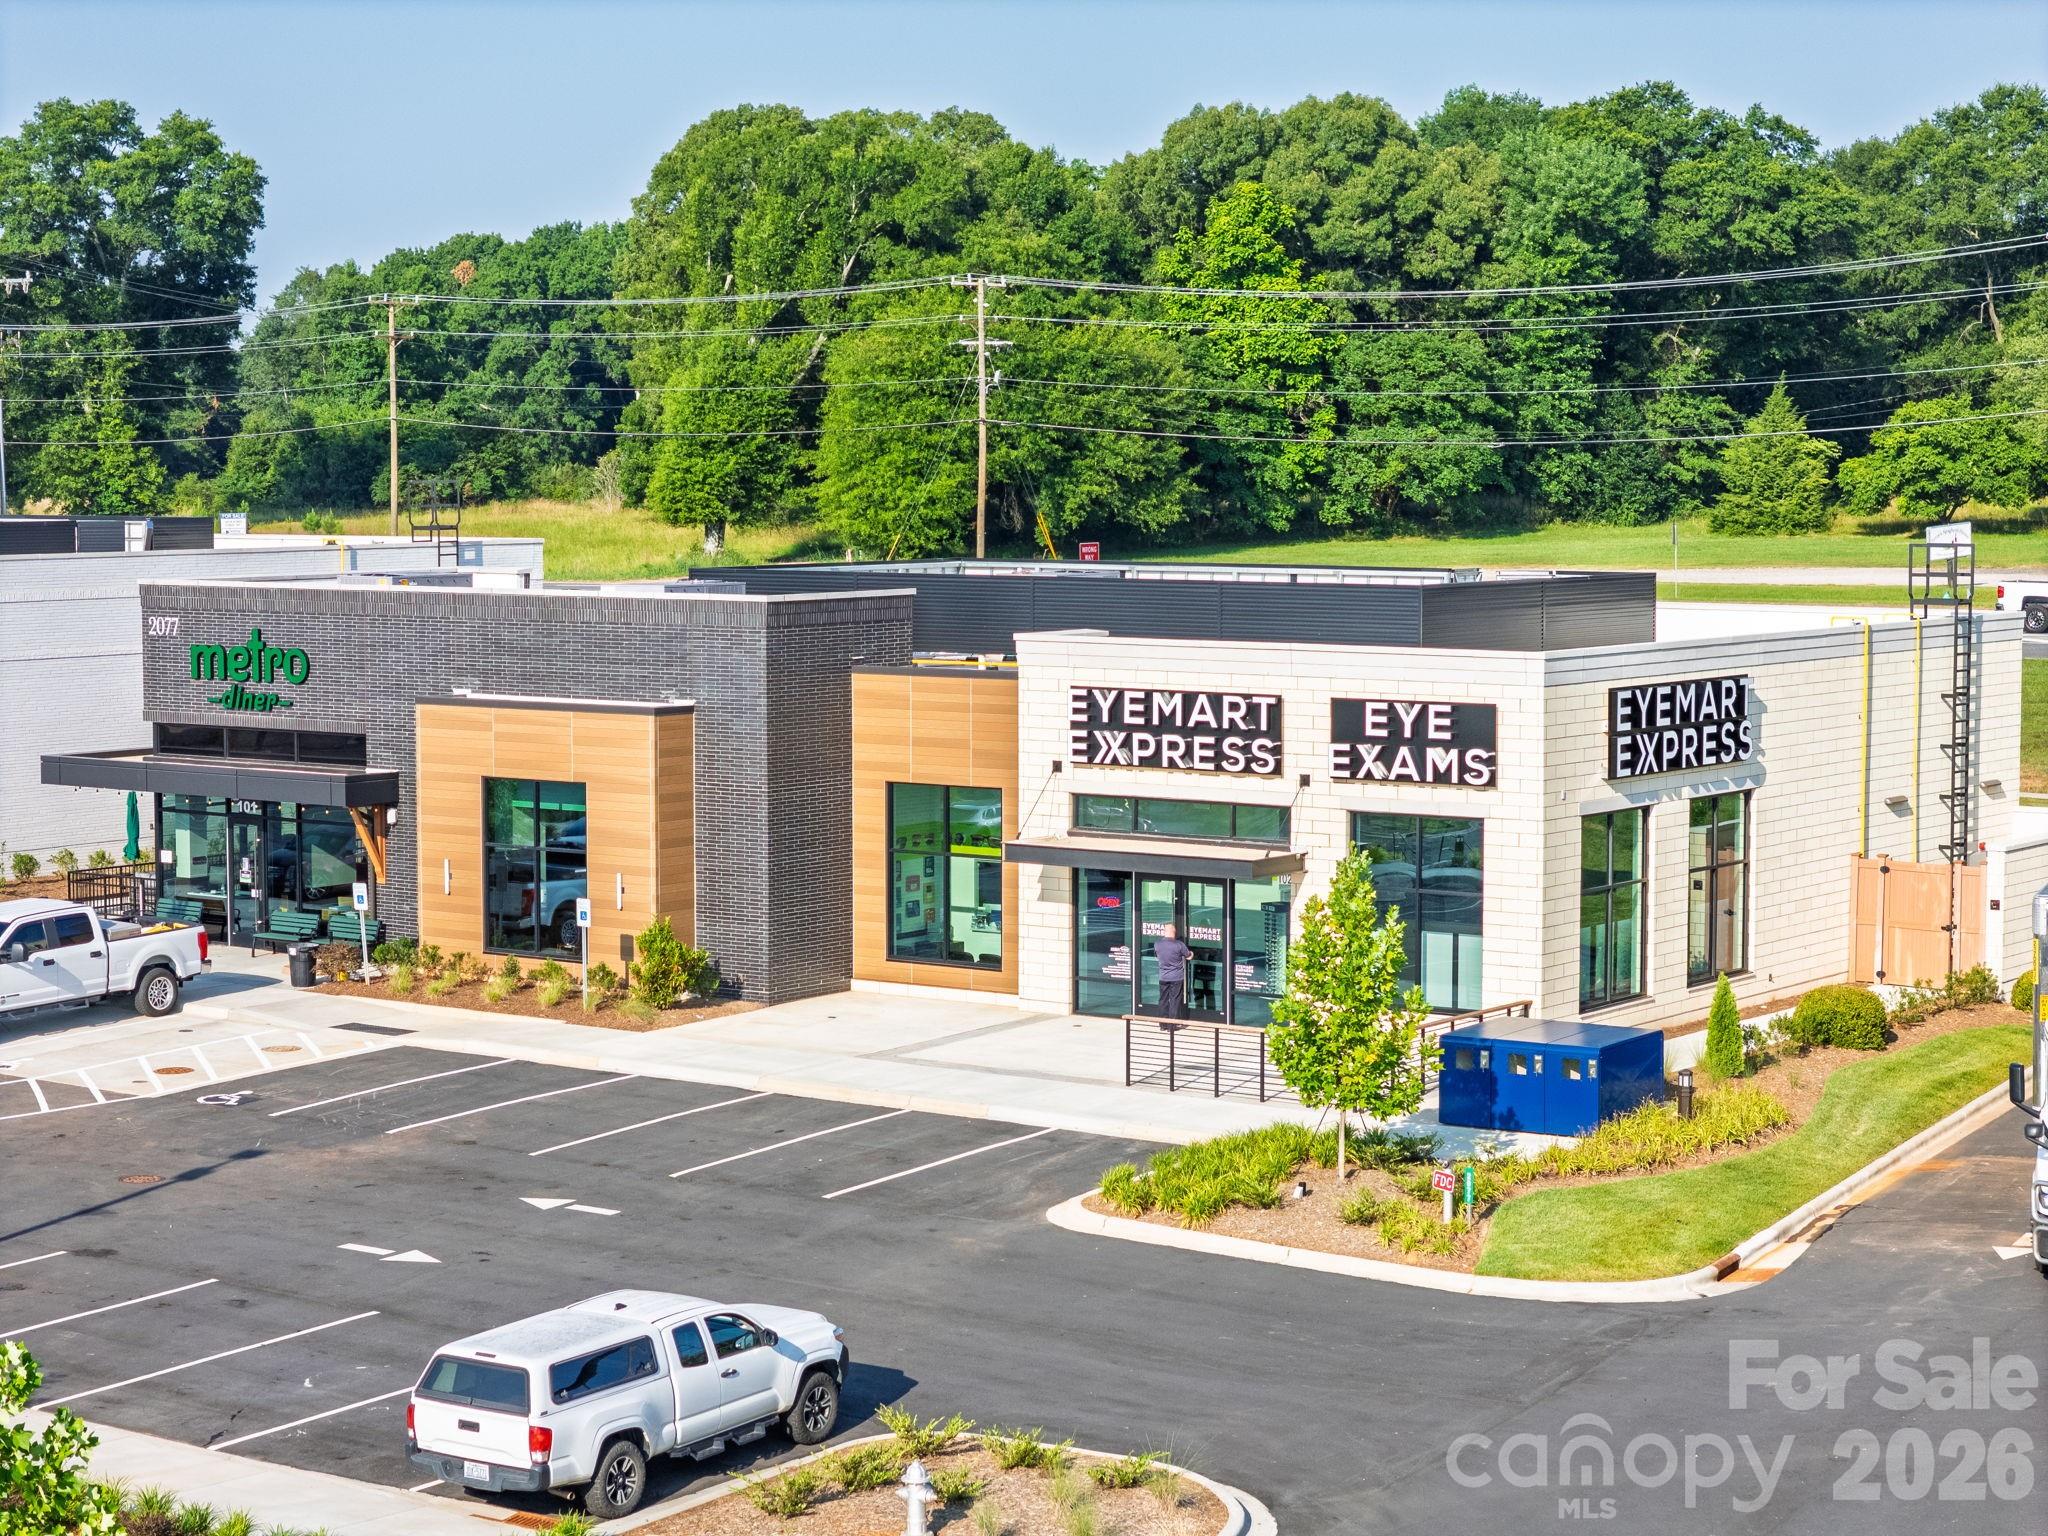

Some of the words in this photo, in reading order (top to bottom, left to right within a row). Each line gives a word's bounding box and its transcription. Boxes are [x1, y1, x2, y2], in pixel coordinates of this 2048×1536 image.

[148, 616, 179, 636] 2077
[190, 626, 310, 685] metro
[1068, 688, 1278, 732] EYEMART
[1364, 701, 1453, 740] EYE
[1616, 677, 1755, 732] EYEMART
[1068, 729, 1277, 774] EXPRESS
[1328, 742, 1491, 786] EXAMS
[1616, 719, 1753, 778] EXPRESS
[237, 800, 257, 814] 101
[1189, 926, 1221, 935] EYEMART
[1189, 933, 1221, 941] EXPRESS
[1434, 1173, 1453, 1189] FDC
